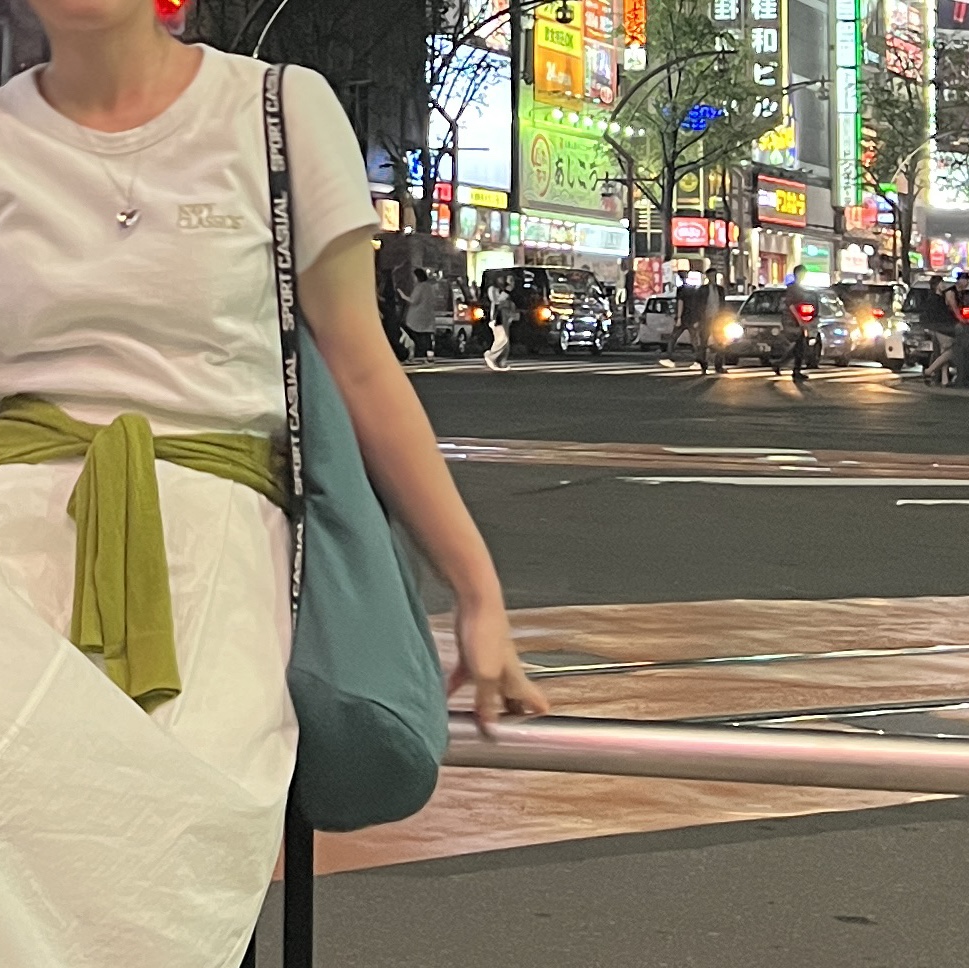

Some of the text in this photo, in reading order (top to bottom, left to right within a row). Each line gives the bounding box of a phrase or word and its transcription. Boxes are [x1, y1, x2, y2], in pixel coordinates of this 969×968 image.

[267, 114, 286, 172] SPORT
[274, 191, 295, 331] SPORT CASUAL
[285, 352, 303, 495] SPORT CASUAL
